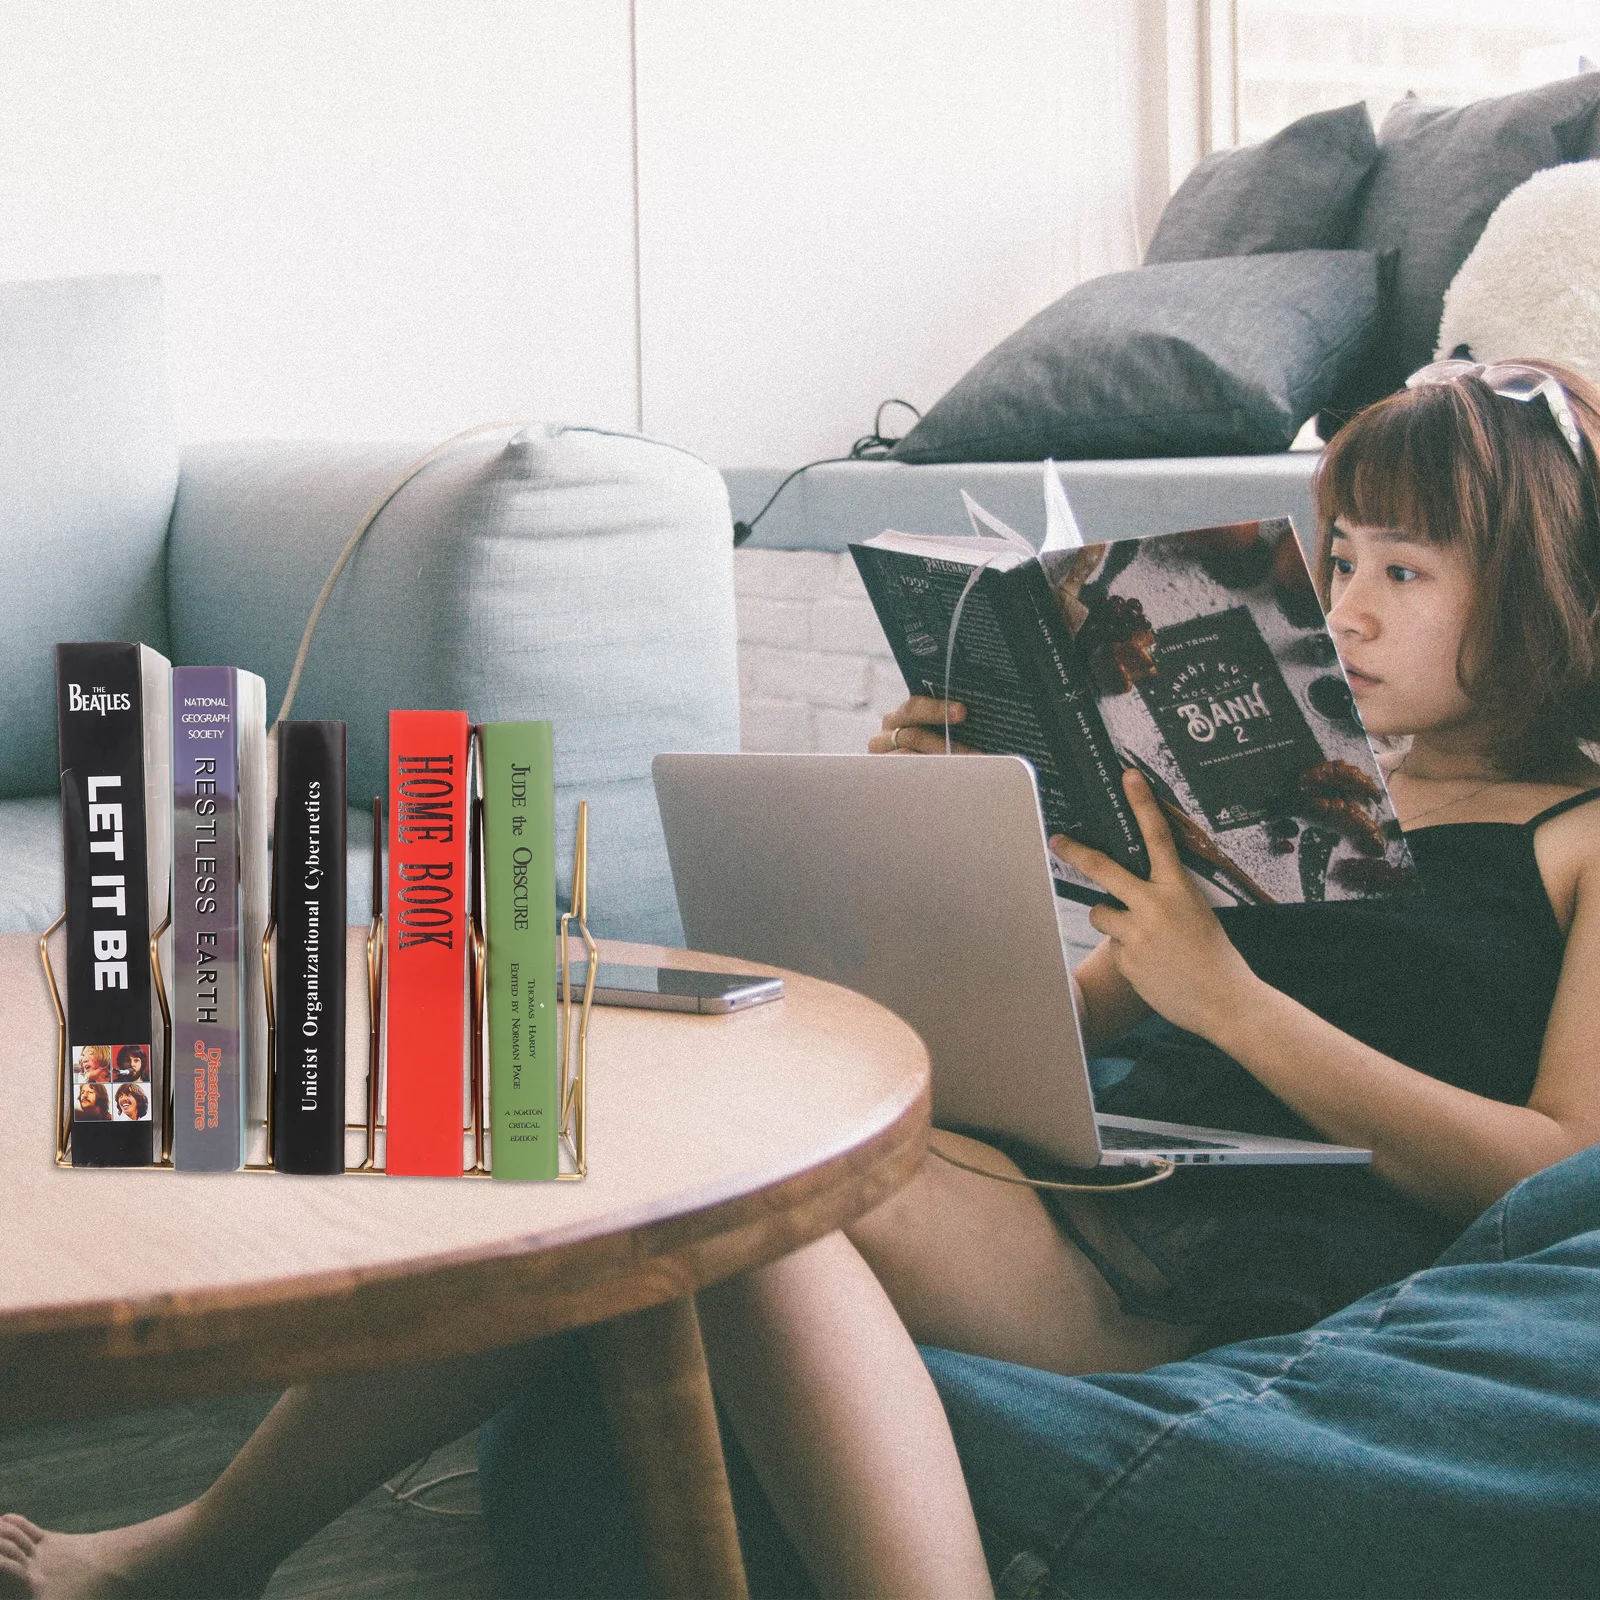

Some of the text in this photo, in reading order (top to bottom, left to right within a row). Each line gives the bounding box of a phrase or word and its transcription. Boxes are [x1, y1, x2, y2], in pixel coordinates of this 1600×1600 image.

[1038, 618, 1053, 645] LINH
[1160, 643, 1183, 654] LINH
[68, 683, 131, 716] BEATLES
[184, 697, 229, 707] NATIONAL
[181, 713, 230, 723] GEOGRAPH
[188, 729, 225, 739] SOCIETY
[1233, 725, 1249, 743] 2
[398, 754, 454, 950] HOME BOOK
[511, 762, 533, 931] JUDE the OBSCURE
[1127, 844, 1140, 854] 2
[88, 775, 129, 991] LET IT BE
[194, 757, 218, 1023] RESTLESS EARTH
[301, 780, 324, 1112] Unicist Organizational Cybernetics
[510, 962, 522, 1090] EDITED BY NORMAN PAGE
[527, 978, 536, 1059] THOMAS HARDY
[194, 1039, 208, 1131] of nature
[207, 1047, 221, 1128] Disasters
[508, 1121, 540, 1129] CRITICAL
[513, 1108, 543, 1116] NORTON
[510, 1134, 539, 1142] EDITION
